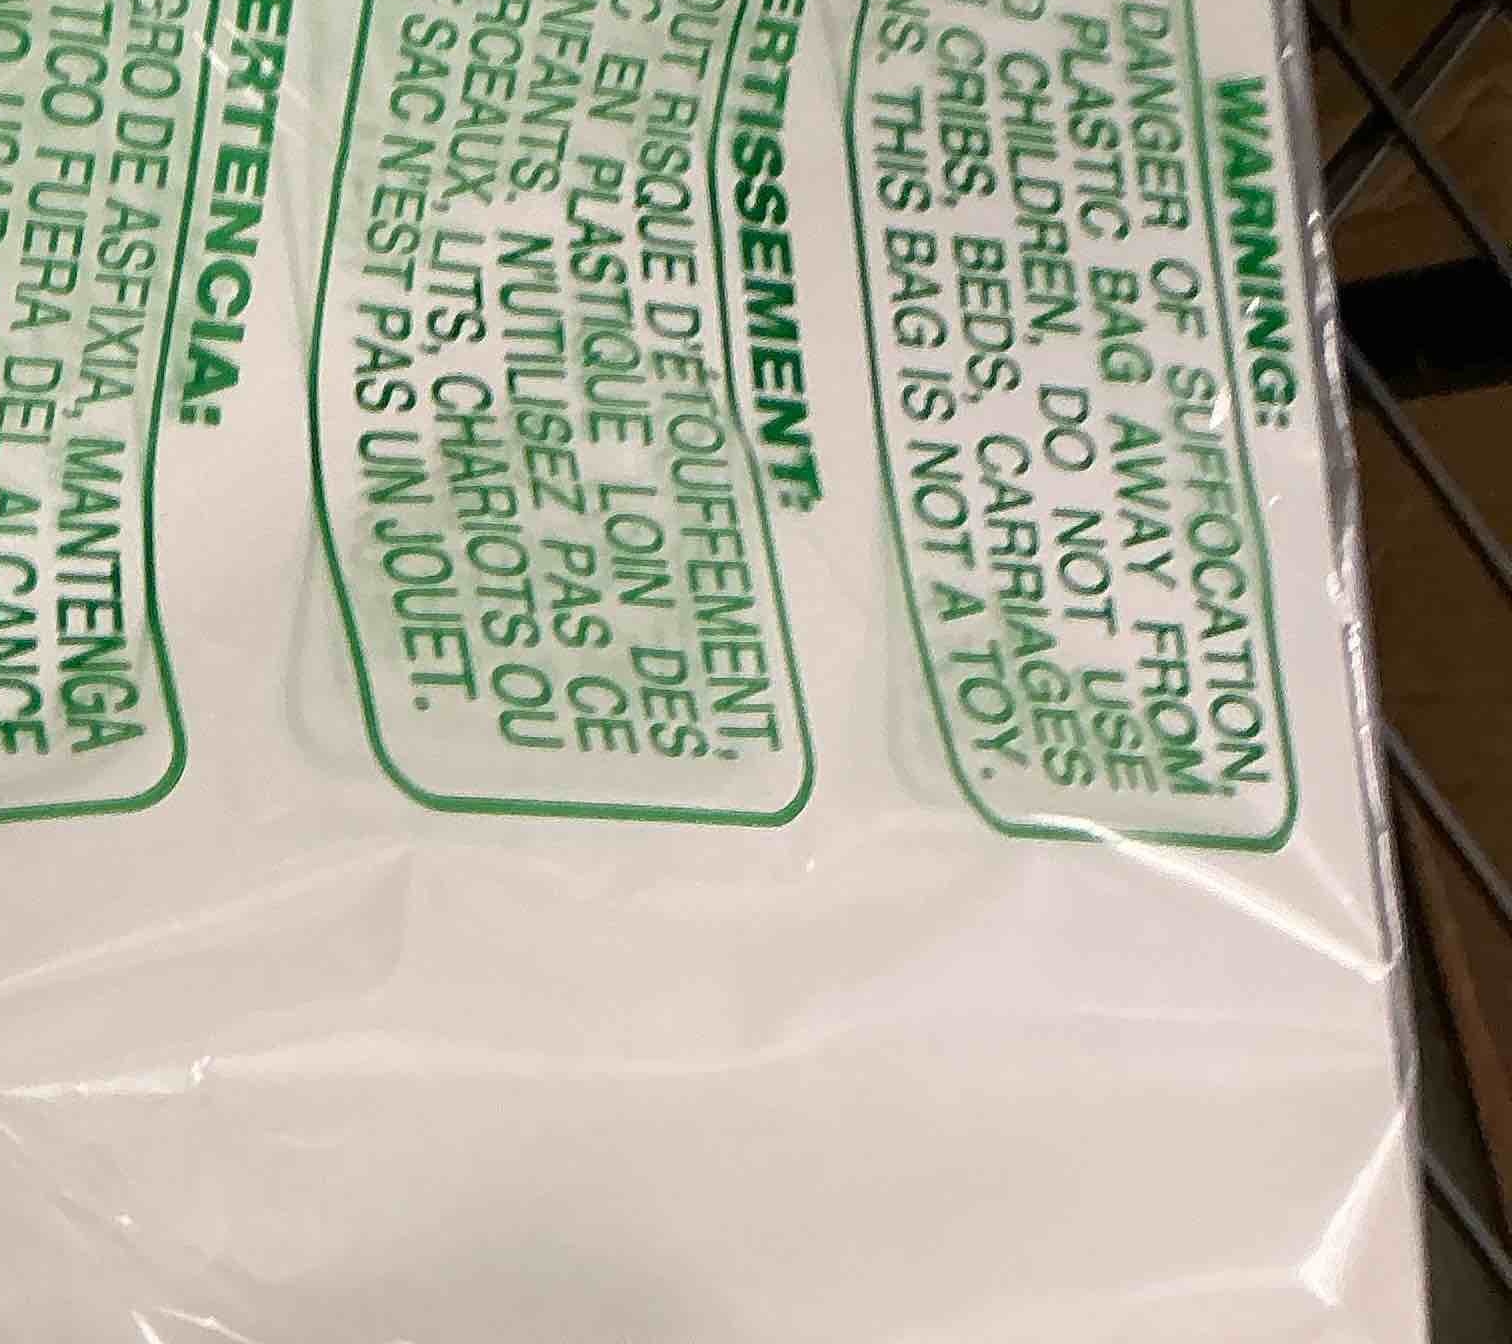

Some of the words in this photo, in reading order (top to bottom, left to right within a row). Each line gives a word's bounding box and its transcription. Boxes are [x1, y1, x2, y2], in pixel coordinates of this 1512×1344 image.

[387, 13, 457, 124] SAC
[587, 53, 646, 122] EN
[1055, 13, 1130, 242] PLASTIC
[1119, 2, 1190, 233] DANGER
[108, 112, 174, 188] DE
[361, 134, 435, 290] N'EST
[632, 90, 700, 286] RISQUE
[870, 86, 932, 214] THIS
[996, 50, 1081, 346] CHILDREN,
[9, 147, 96, 330] FUERA
[421, 230, 488, 355] LITS,
[566, 155, 654, 445] PLASTIQUE
[884, 229, 947, 349] BAG
[1147, 259, 1207, 338] OF
[1215, 76, 1297, 432] WARNING:
[63, 199, 162, 418] ASFIXIA,
[354, 303, 417, 413] PAS
[950, 235, 1022, 405] BEDS,
[1087, 266, 1153, 385] BAG
[495, 232, 583, 515] N'UTILISEZ
[899, 368, 956, 422] IS
[1035, 385, 1097, 473] DO
[356, 430, 432, 504] UN
[430, 373, 541, 648] CHARIOTS
[906, 441, 977, 570] NOT
[1104, 415, 1176, 591] AWAY
[52, 435, 145, 753] MANTENGA
[541, 539, 612, 648] PAS
[597, 483, 676, 608] LOIN
[930, 582, 986, 622] A
[1051, 508, 1117, 635] NOT
[1163, 364, 1270, 799] SUFFOCATION,
[372, 519, 477, 712] JOUET.
[975, 434, 1096, 786] CARRIAGES
[490, 663, 563, 749] OU
[564, 675, 639, 754] CE
[628, 646, 708, 759] DES
[948, 641, 1031, 780] TOY.
[1078, 670, 1158, 792] USE
[1130, 621, 1211, 796] FROM
